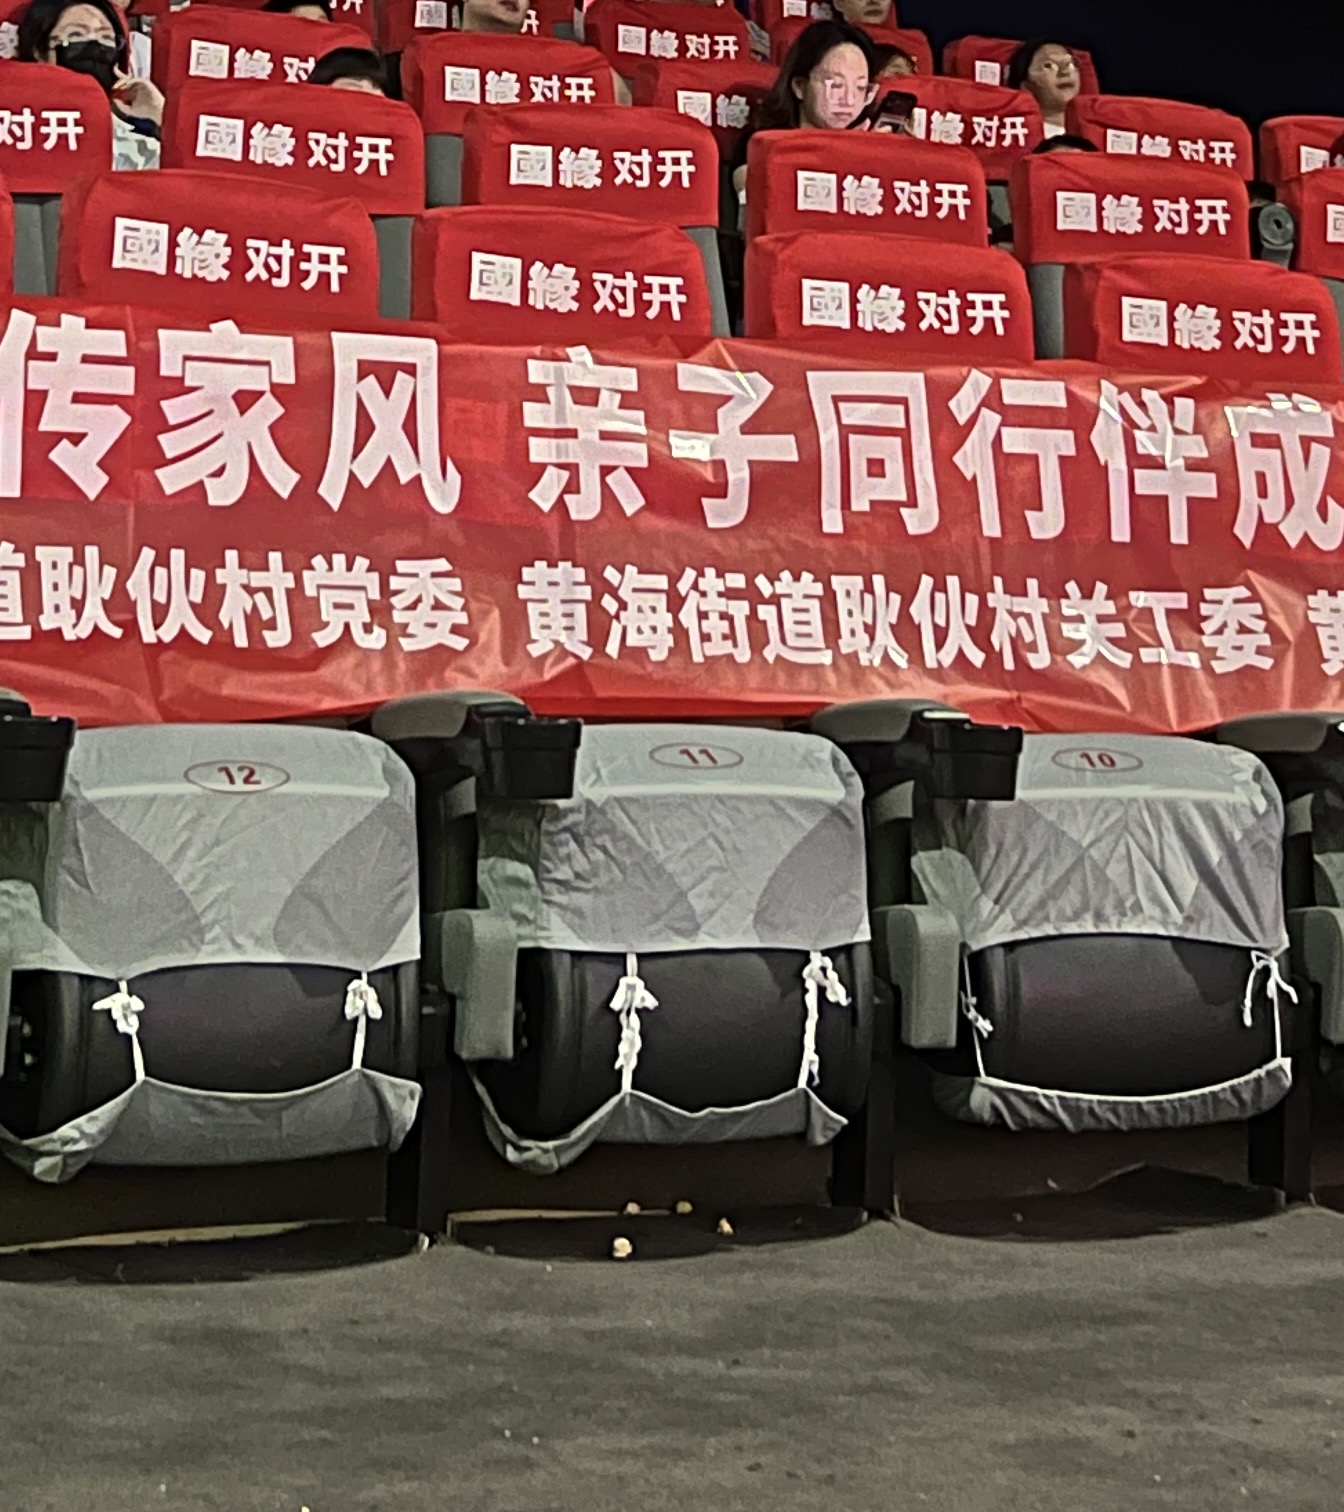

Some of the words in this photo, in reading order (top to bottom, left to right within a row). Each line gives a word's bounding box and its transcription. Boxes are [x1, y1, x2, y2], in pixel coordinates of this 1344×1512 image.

[685, 34, 738, 59] 对开
[530, 75, 595, 103] 对开
[972, 116, 1028, 147] 对开
[308, 132, 394, 176] 对开
[613, 149, 695, 188] 对开
[893, 180, 970, 220] 对开
[1153, 197, 1230, 235] 对开
[245, 239, 348, 292] 对开
[592, 272, 686, 320] 对开
[917, 290, 1009, 335] 对开
[1232, 309, 1320, 354] 对开
[518, 560, 1275, 671] 黄海街道耿伙村关工委
[218, 764, 261, 786] 12
[679, 748, 718, 766] 11
[1079, 752, 1117, 770] 10
